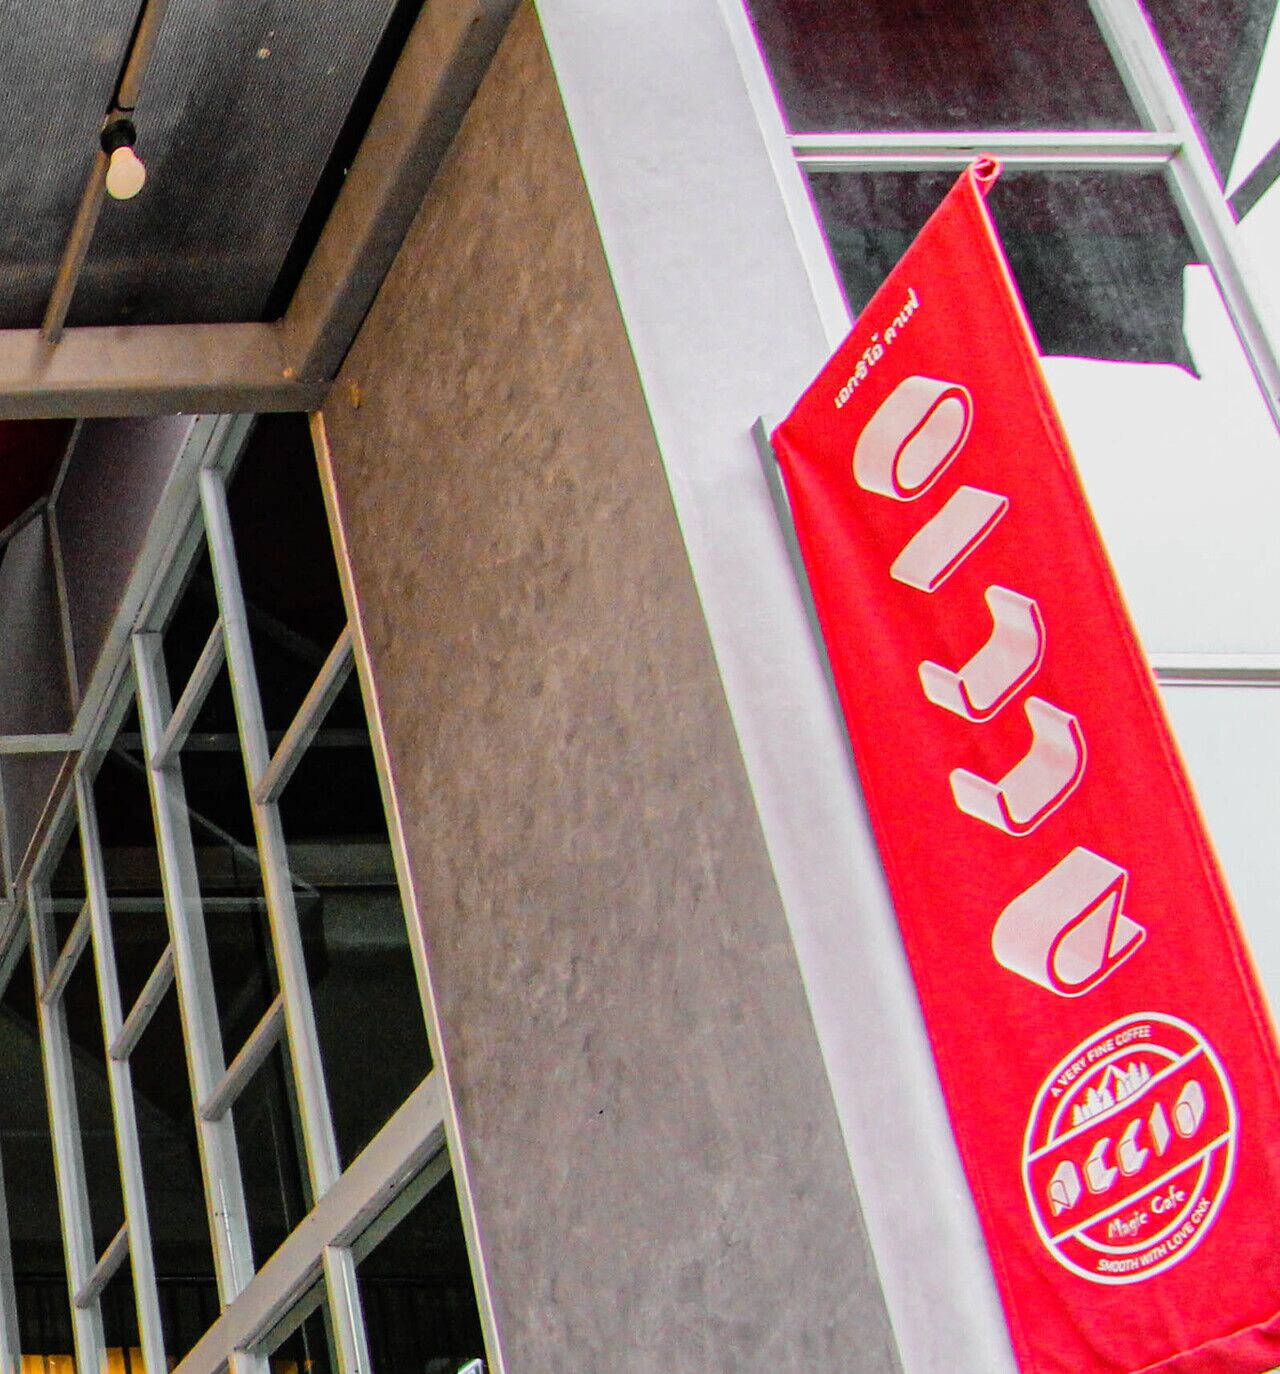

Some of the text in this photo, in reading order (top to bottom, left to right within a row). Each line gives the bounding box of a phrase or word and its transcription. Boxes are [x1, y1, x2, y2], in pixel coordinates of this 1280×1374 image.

[1057, 1057, 1087, 1086] VERY
[1086, 1038, 1116, 1063] FINE
[1115, 1025, 1152, 1047] COFFEE
[1097, 1259, 1140, 1272] SMOOTH
[1139, 1244, 1168, 1266] WITH
[1166, 1221, 1195, 1251] LOVE
[1108, 1211, 1148, 1239] Magic
